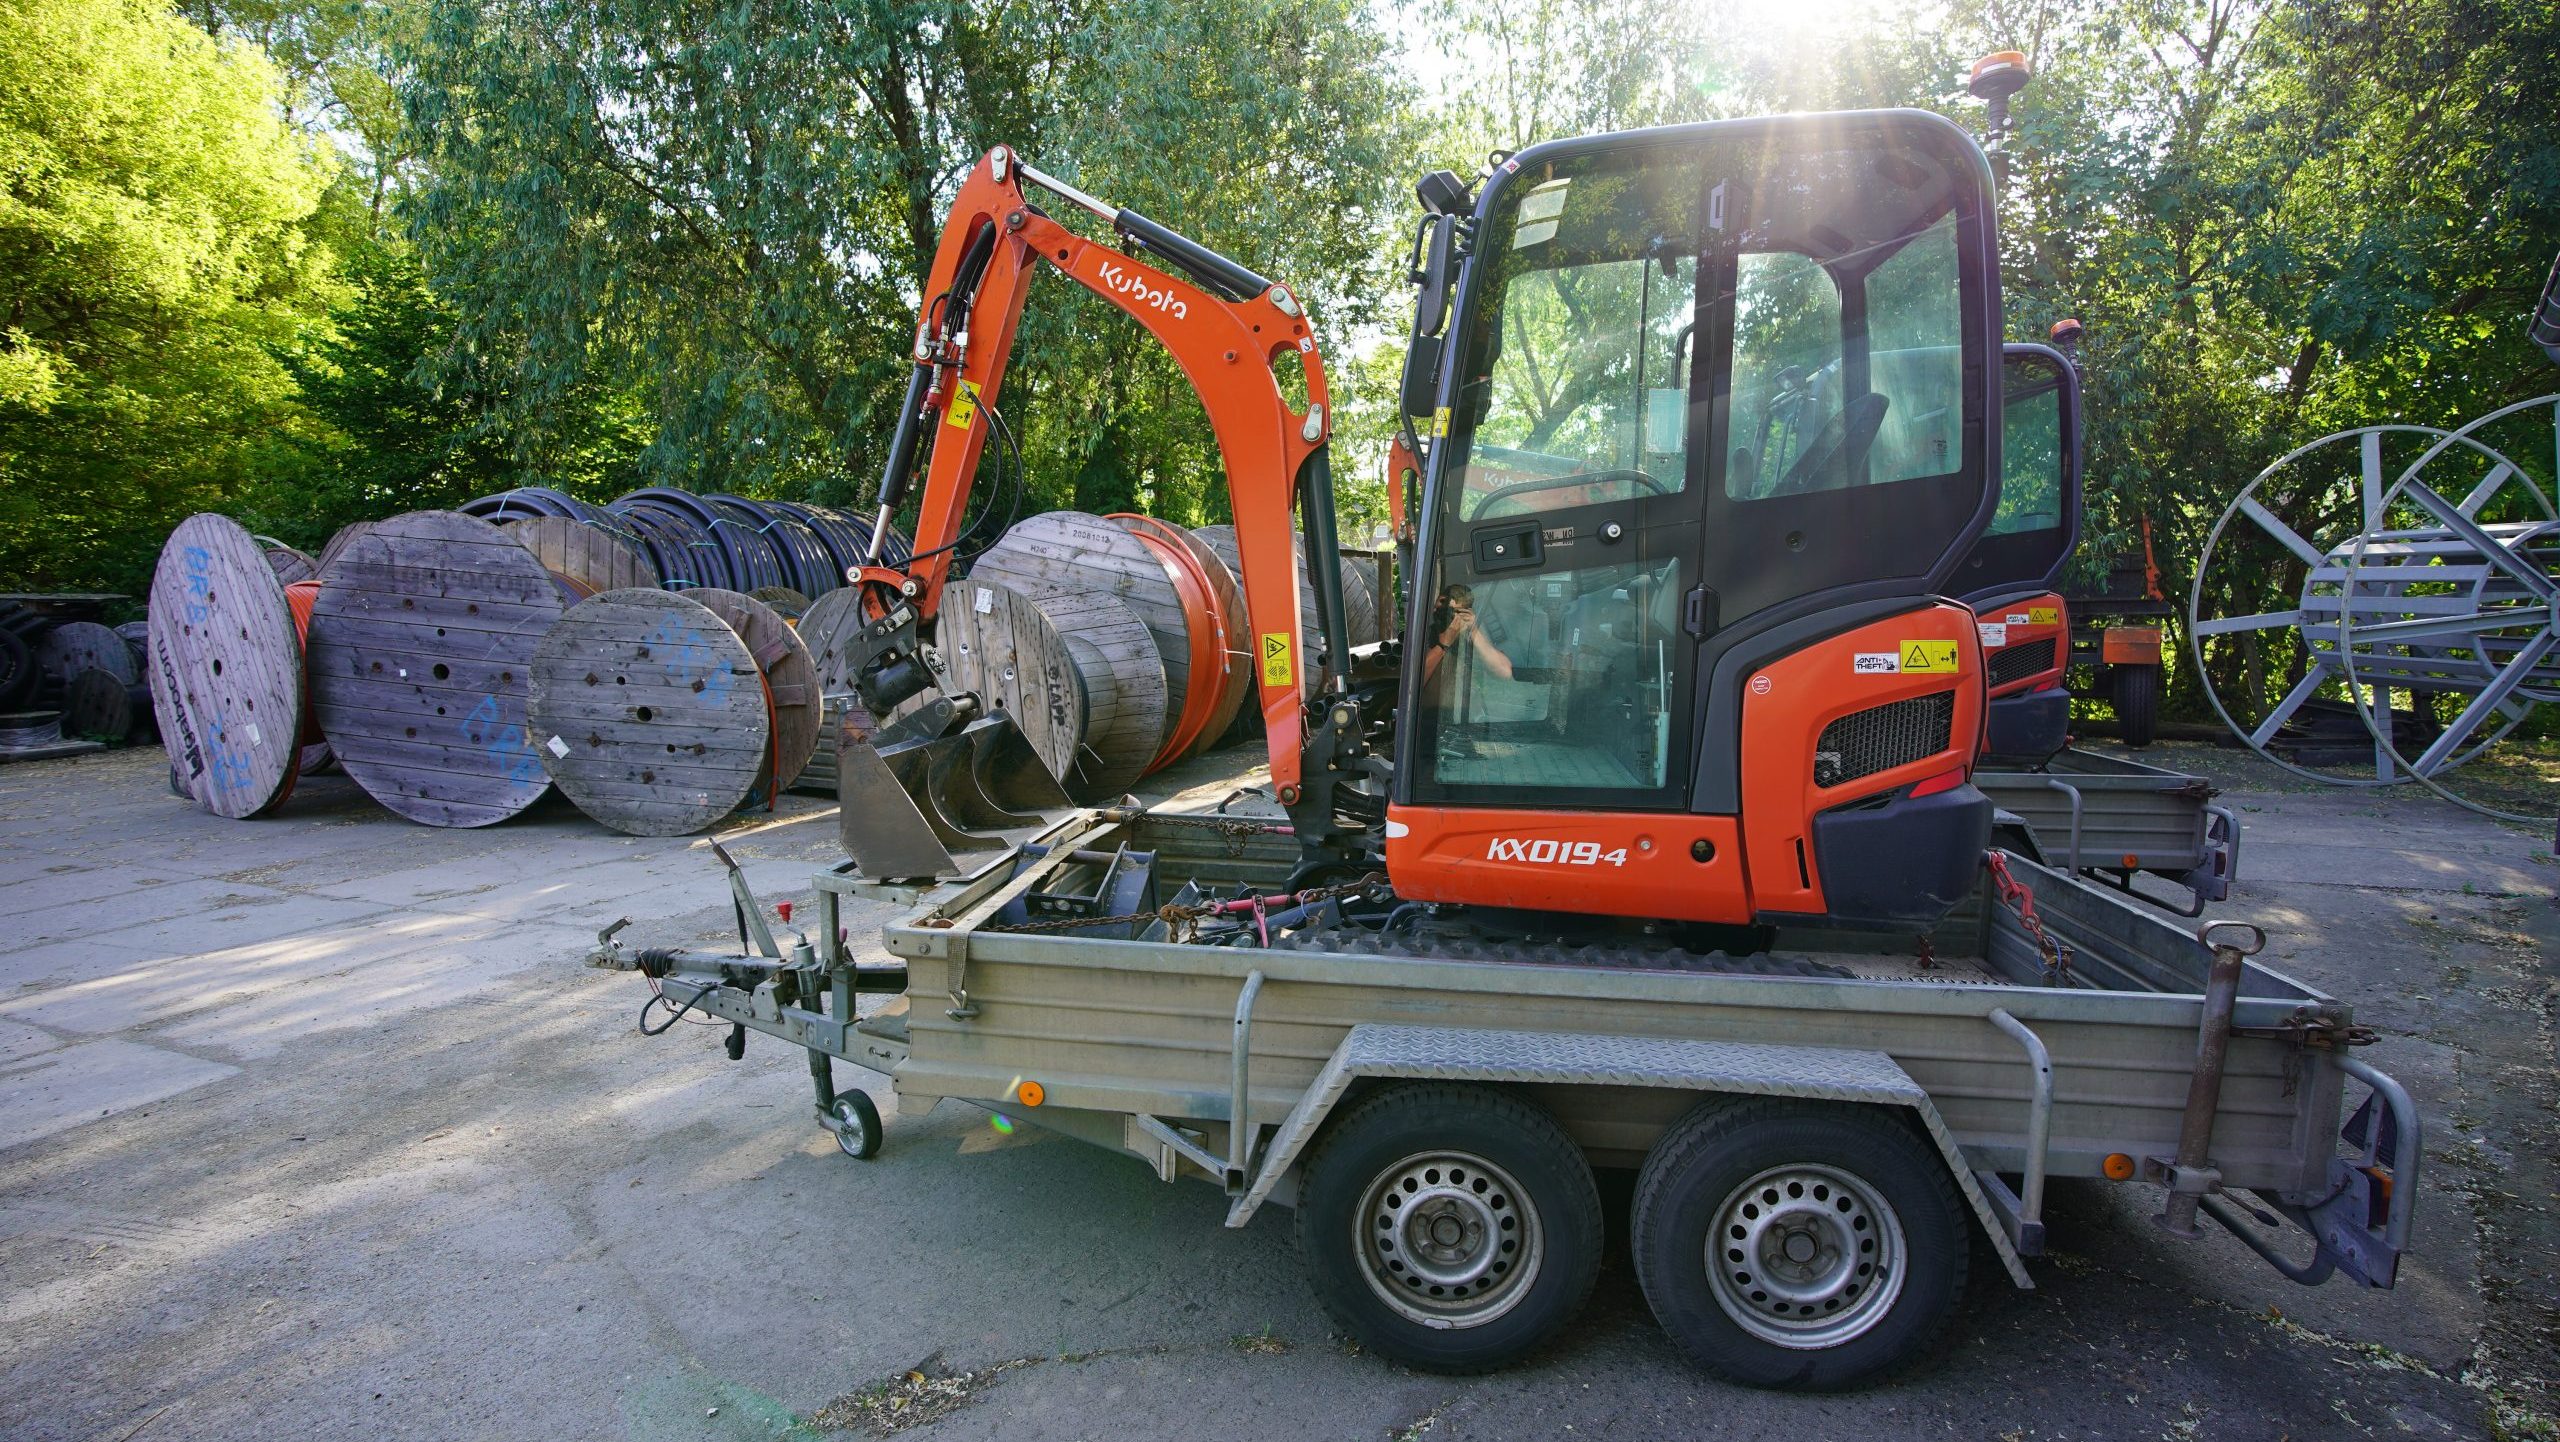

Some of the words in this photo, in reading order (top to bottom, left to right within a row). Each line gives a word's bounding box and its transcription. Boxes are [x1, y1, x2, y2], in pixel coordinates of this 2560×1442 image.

[1098, 261, 1187, 320] Kubota
[1049, 684, 1066, 728] LAPP
[1486, 837, 1628, 867] KX019-4
